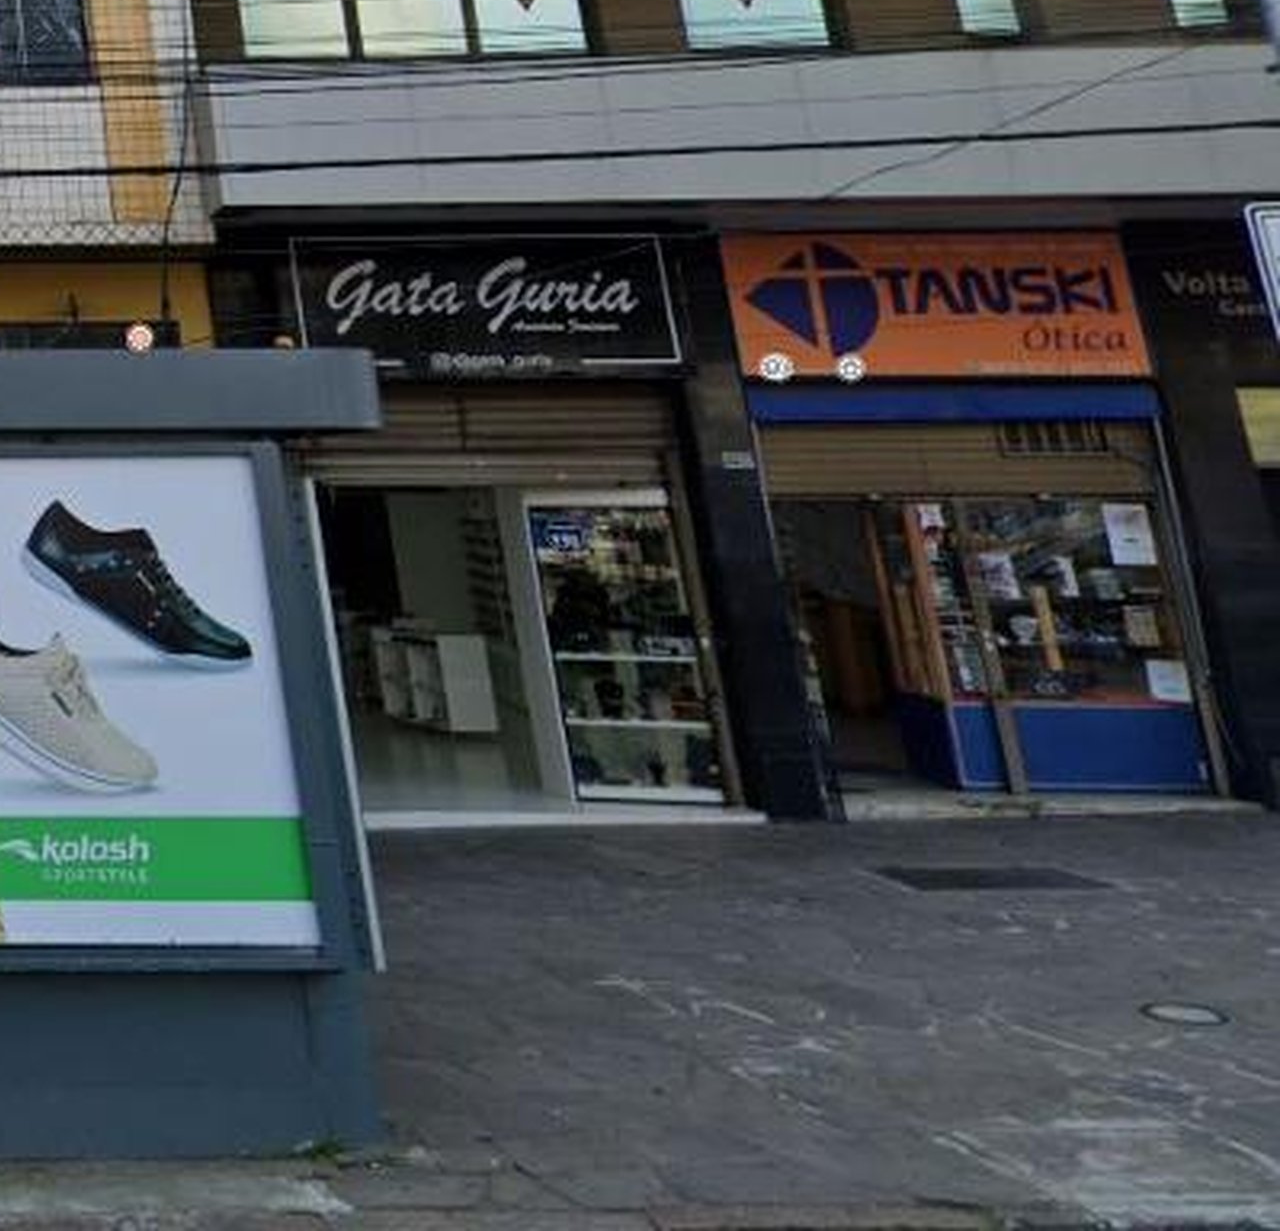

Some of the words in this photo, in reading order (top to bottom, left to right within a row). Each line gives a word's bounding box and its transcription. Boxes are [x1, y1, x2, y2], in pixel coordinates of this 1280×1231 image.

[326, 259, 465, 335] Gata
[477, 256, 639, 335] Guria
[875, 266, 1120, 315] TANSKI
[1161, 270, 1251, 296] Volta
